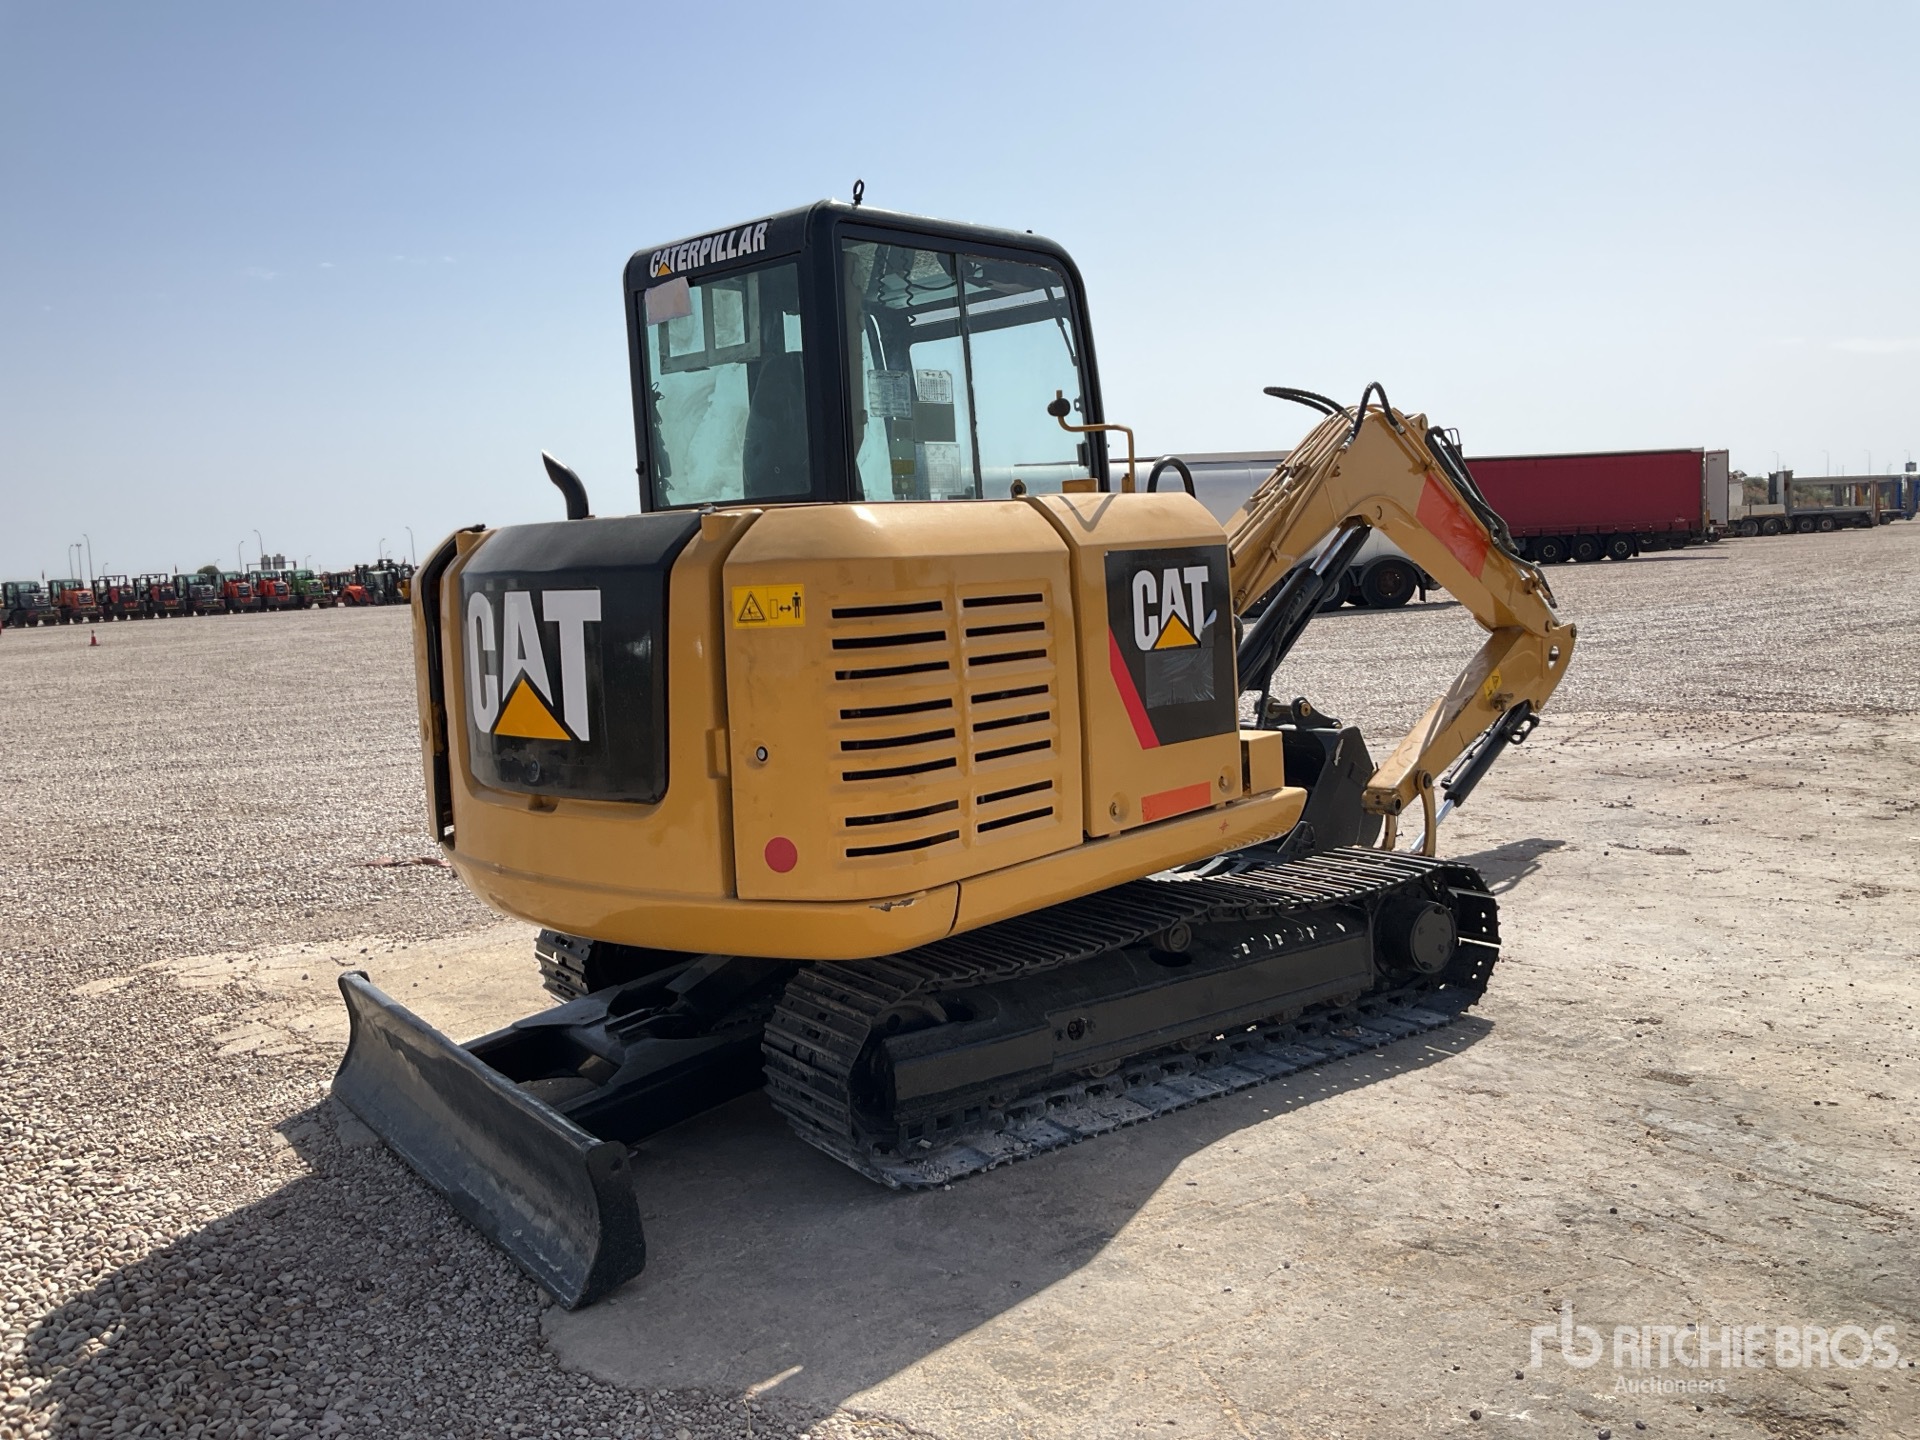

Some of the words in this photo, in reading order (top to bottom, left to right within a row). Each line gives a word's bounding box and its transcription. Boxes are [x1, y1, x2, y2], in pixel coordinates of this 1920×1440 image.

[649, 221, 768, 278] CATERPILLAR
[1131, 565, 1209, 651] CAT
[467, 588, 602, 742] CAT
